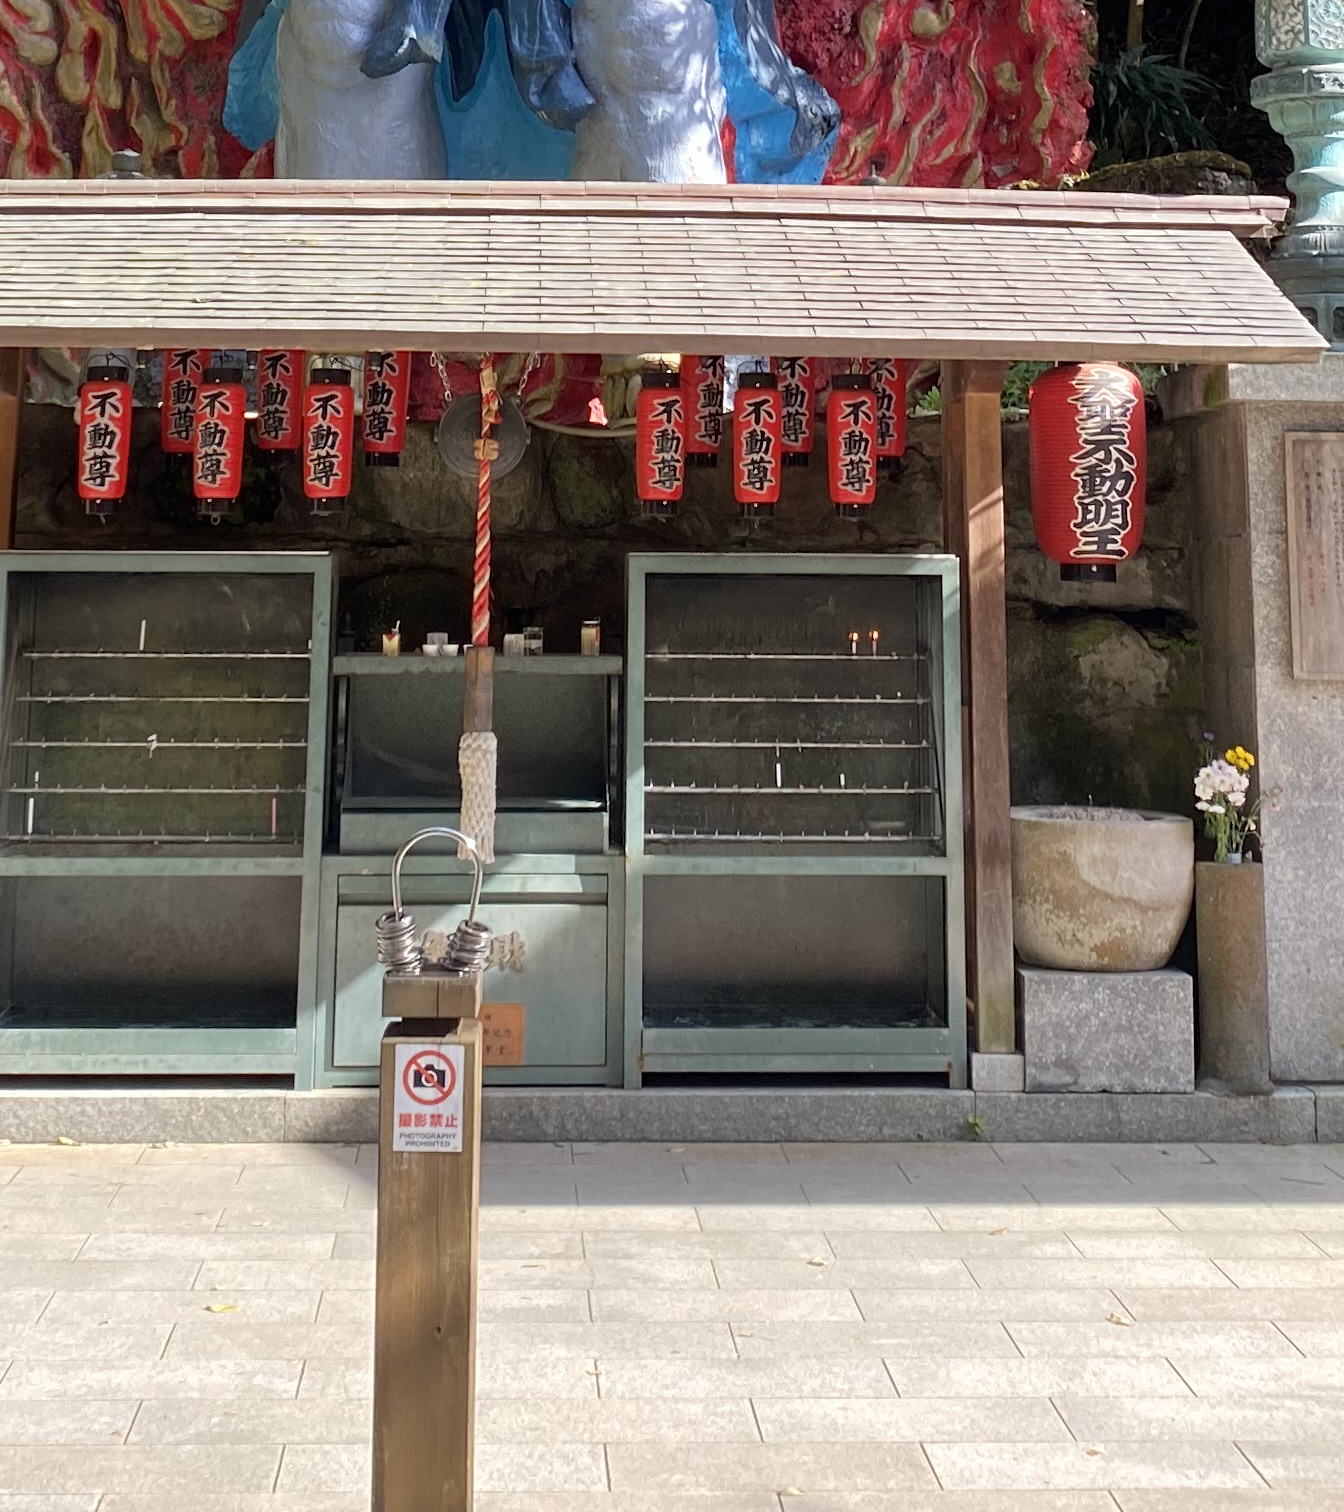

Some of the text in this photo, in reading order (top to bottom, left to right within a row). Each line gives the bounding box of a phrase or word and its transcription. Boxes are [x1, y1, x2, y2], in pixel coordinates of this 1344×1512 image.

[84, 391, 121, 487] 不動尊
[169, 349, 202, 441] 不動尊
[197, 390, 231, 485] 不動尊
[260, 352, 291, 440] 不動尊
[308, 393, 342, 488] 不動尊
[365, 352, 397, 441] 不動尊
[651, 398, 683, 490] 不動尊
[741, 398, 775, 491] 不動尊
[839, 399, 872, 493] 不動尊
[1069, 369, 1137, 558] 大聖不動明王
[399, 1113, 458, 1127] 撮影禁止
